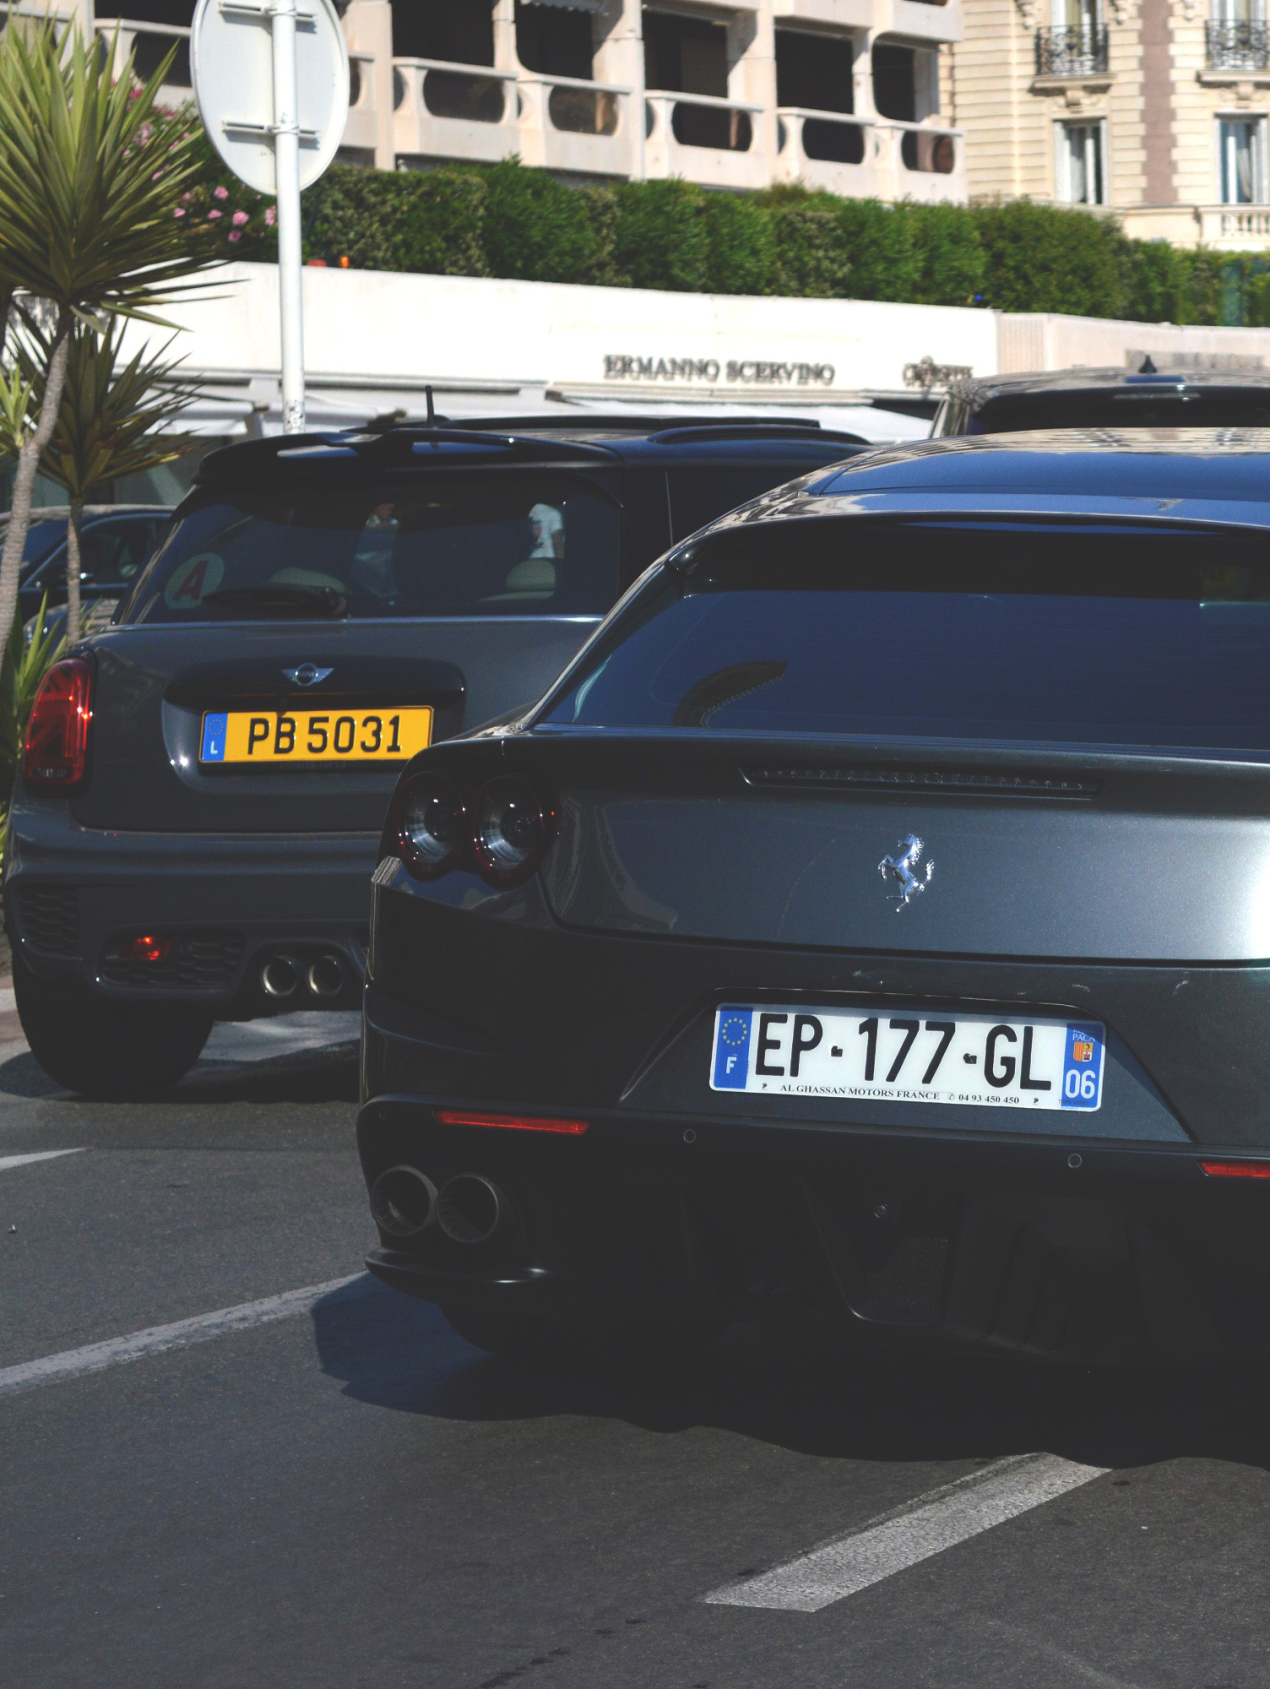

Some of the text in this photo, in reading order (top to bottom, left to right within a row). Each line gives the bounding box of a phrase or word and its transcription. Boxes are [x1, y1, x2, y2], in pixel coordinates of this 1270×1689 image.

[604, 354, 836, 386] ERMANNO SCERVINO
[725, 1055, 737, 1074] F
[780, 1084, 795, 1092] AL
[796, 1084, 846, 1095] GHASSAN
[849, 1088, 894, 1097] MOTORS
[897, 1090, 940, 1100] FRANCE
[971, 1094, 982, 1102] 93
[984, 1095, 1001, 1103] 450
[1003, 1096, 1020, 1104] 450
[1065, 1068, 1096, 1099] 06
